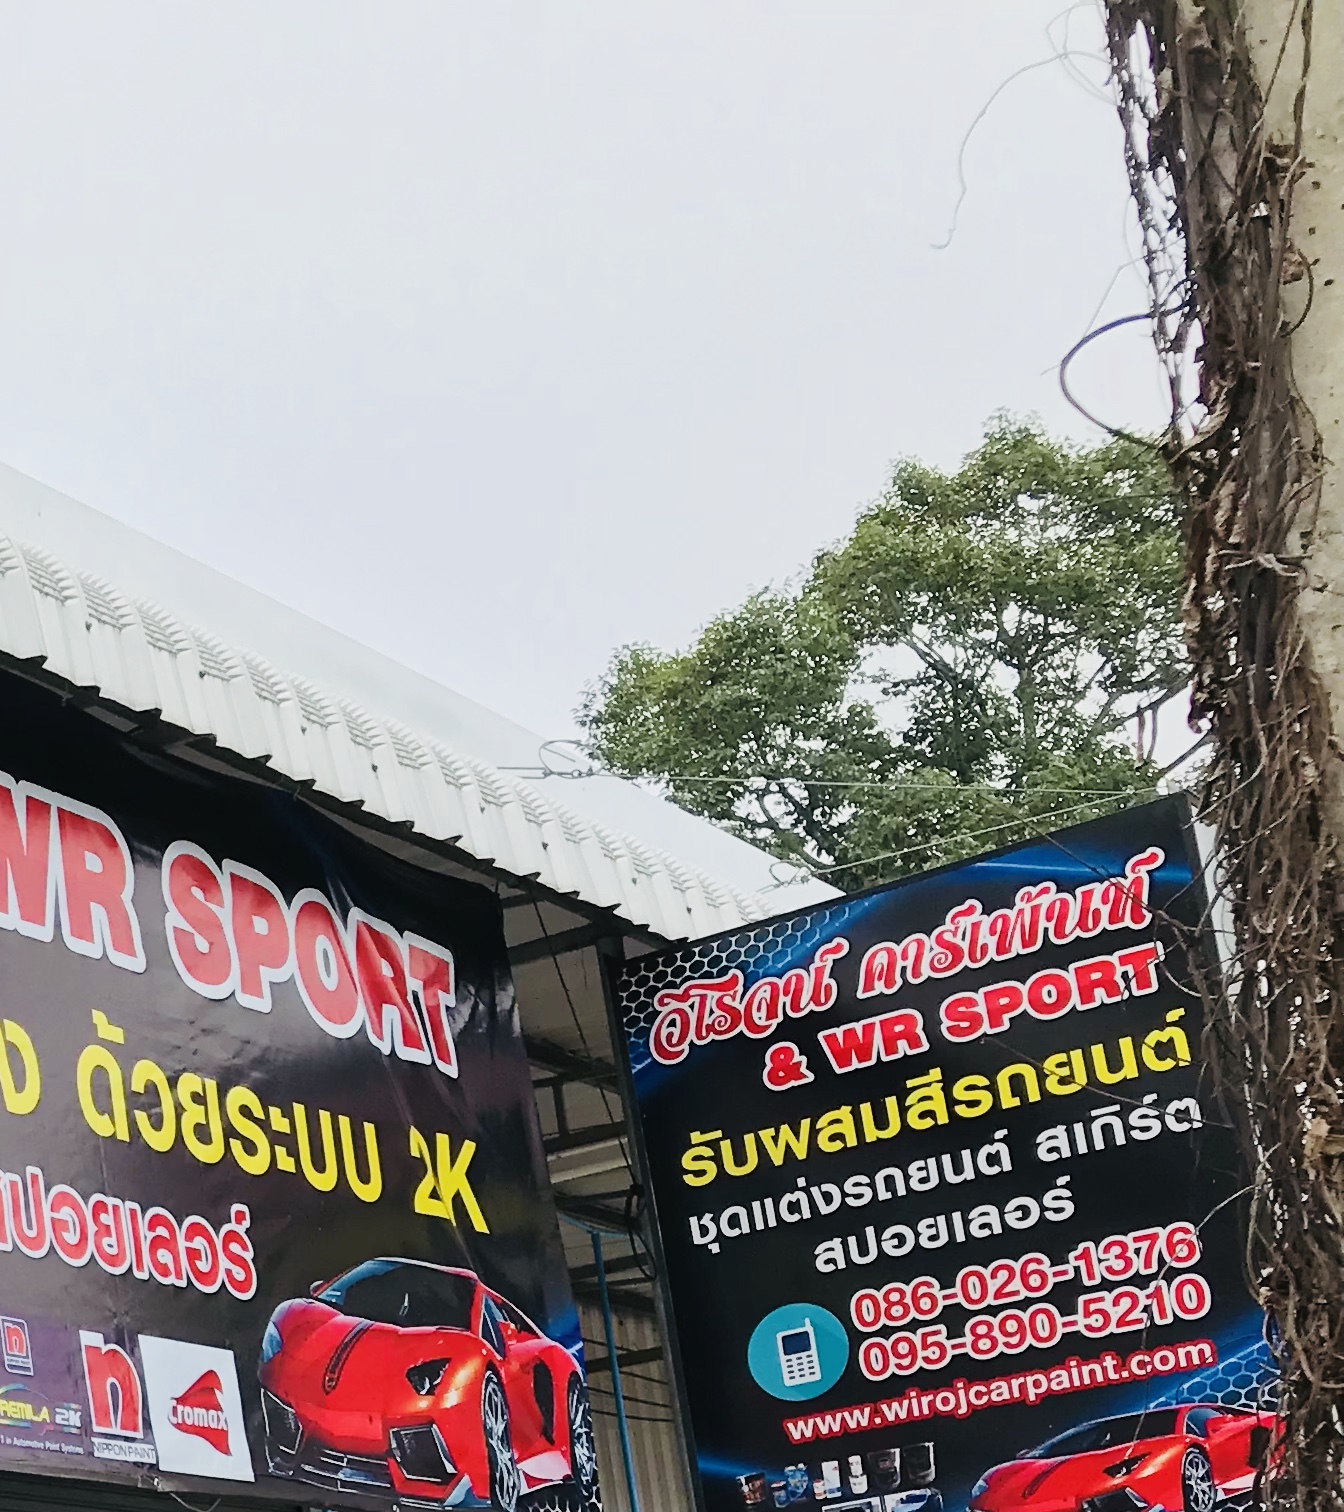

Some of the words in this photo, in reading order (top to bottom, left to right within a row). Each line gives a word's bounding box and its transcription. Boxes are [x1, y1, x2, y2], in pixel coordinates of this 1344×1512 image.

[162, 841, 458, 1077] SPORT
[763, 1041, 814, 1090] &
[818, 1009, 929, 1075] WR
[940, 941, 1166, 1042] SPORT
[76, 1009, 382, 1203] ด้วยระบบ
[410, 1124, 490, 1235] 2K
[680, 1008, 1191, 1187] รับผสมสีรถยนต์
[689, 1128, 1012, 1254] ชุดแต่งรถยนต์
[1036, 1093, 1204, 1162] สเกิร์ต
[814, 1175, 1075, 1273] สปอยเลอร์
[850, 1221, 1200, 1333] 086-026-1376
[859, 1273, 1211, 1382] 095-890-5210
[54, 1407, 82, 1427] 2K
[169, 1399, 229, 1431] Cromax
[786, 1340, 1215, 1442] www.wirojcarpaint.com
[93, 1440, 128, 1456] NIPPON
[128, 1444, 156, 1460] PAINT
